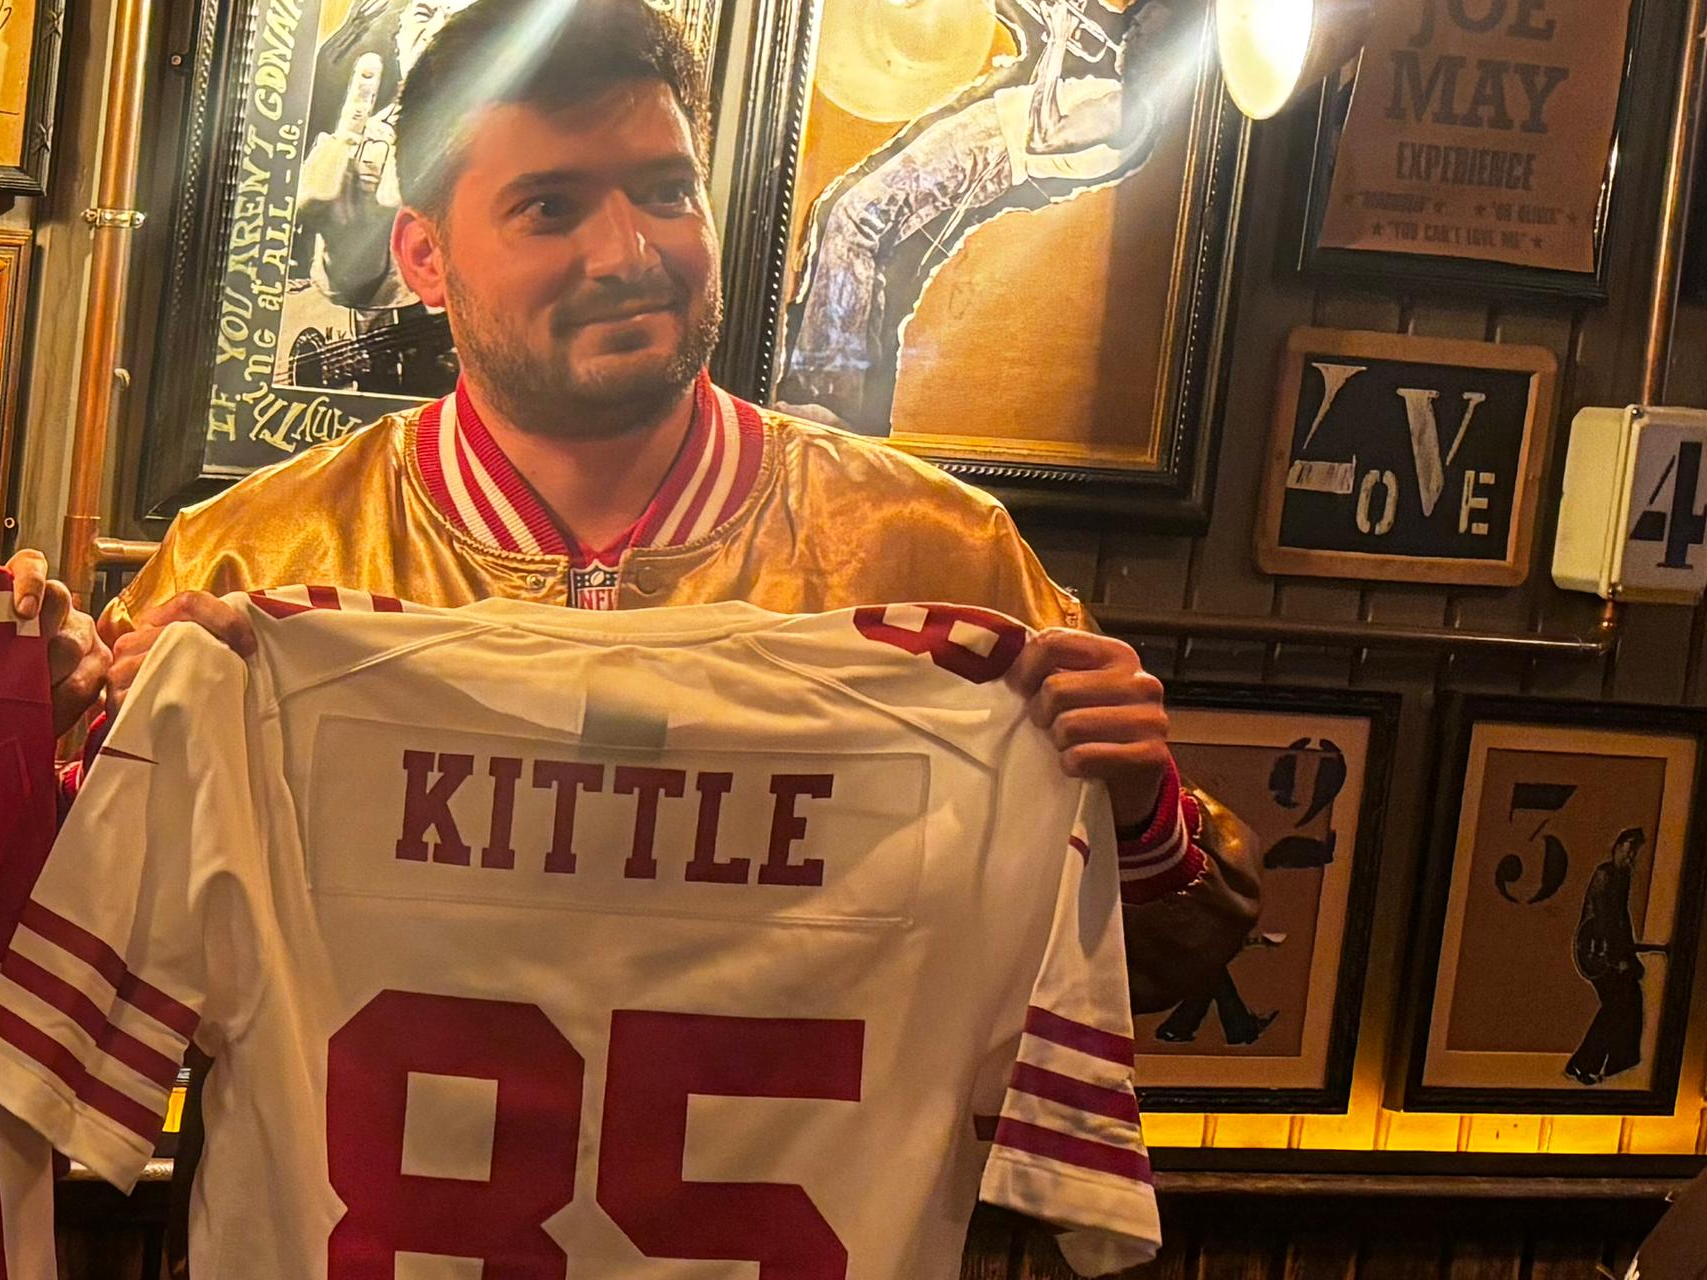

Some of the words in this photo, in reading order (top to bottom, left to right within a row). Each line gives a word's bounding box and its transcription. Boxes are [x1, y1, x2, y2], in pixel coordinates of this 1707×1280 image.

[1385, 50, 1571, 135] MAY
[1395, 141, 1537, 192] EXPERIENCE
[262, 196, 294, 276] ALL
[216, 287, 252, 366] YOU
[207, 384, 236, 441] IF
[1285, 362, 1497, 538] LOVE
[1630, 440, 1707, 569] 4
[396, 749, 834, 886] KITTLE
[1494, 782, 1578, 904] 3
